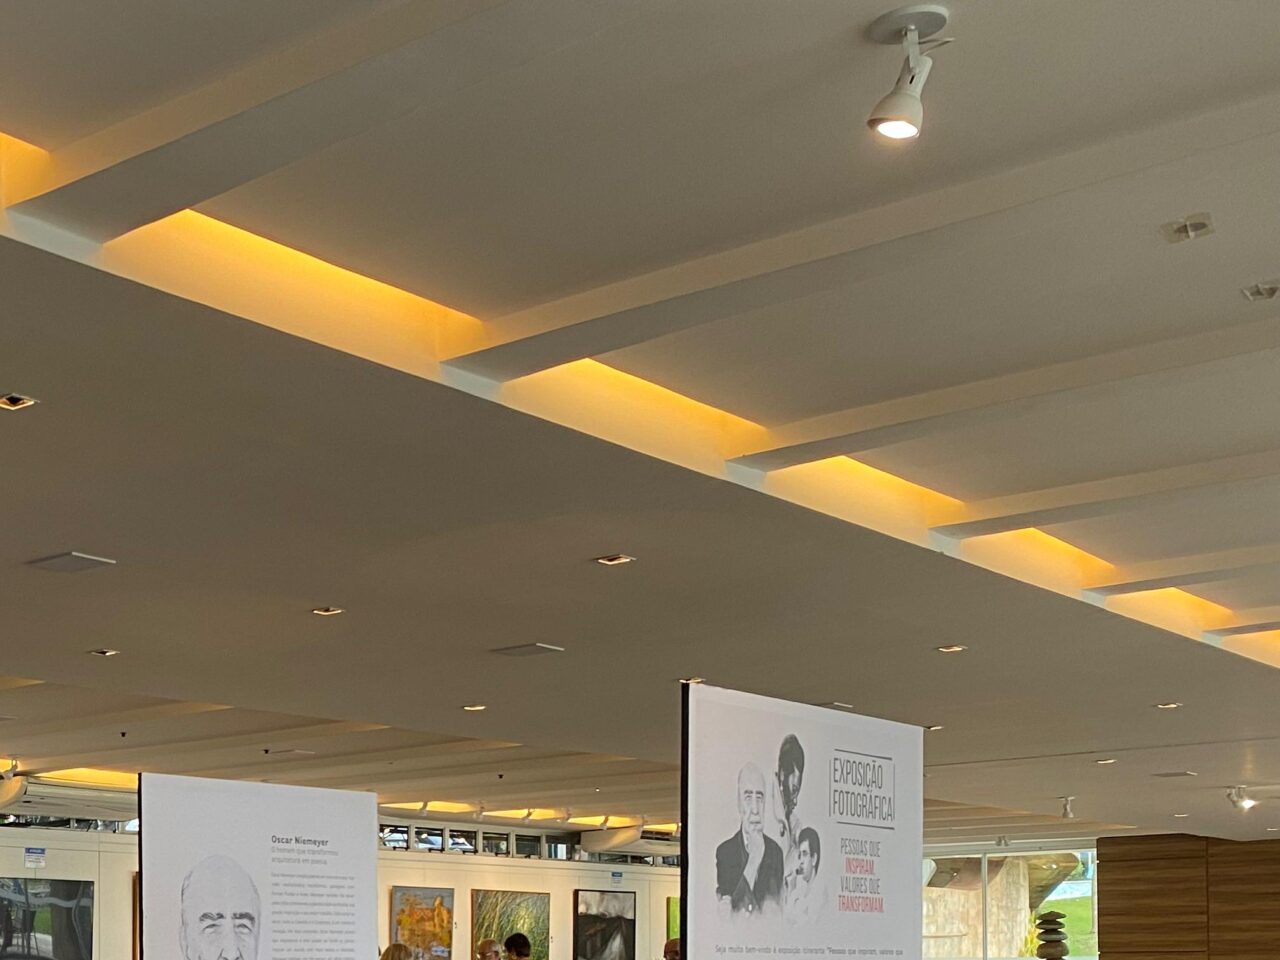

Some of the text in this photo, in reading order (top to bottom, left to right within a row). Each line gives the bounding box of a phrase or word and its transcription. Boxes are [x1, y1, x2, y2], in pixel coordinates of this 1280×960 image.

[833, 757, 883, 791] EXPOSIÇÃO
[833, 790, 893, 821] FOTOGRÁFICA
[272, 835, 329, 848] Oscar Niemeyer
[840, 838, 881, 857] PESSOAS QUE
[840, 876, 881, 894] VALORES QUE
